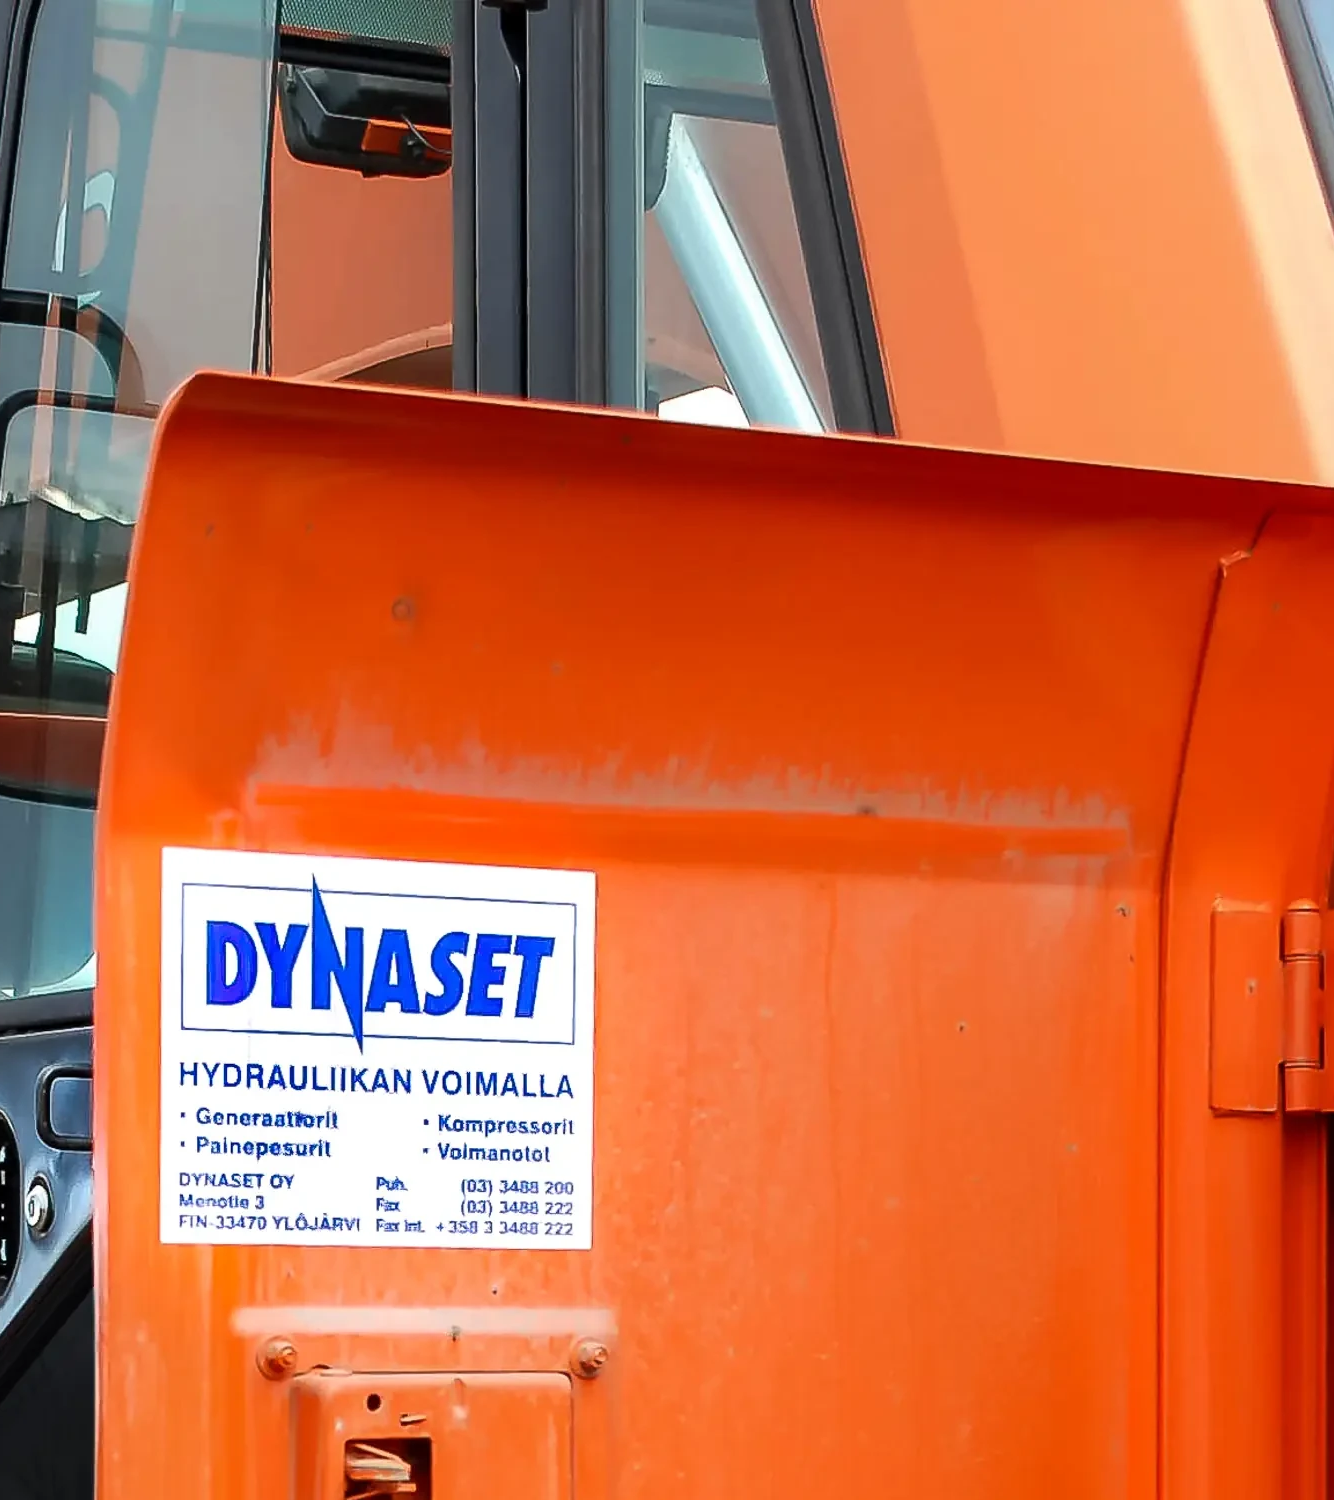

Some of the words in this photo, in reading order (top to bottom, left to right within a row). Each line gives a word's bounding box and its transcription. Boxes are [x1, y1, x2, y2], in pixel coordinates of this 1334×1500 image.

[206, 874, 555, 1055] DYNASET
[179, 1062, 412, 1095] HYDRAULIIKAN
[421, 1069, 574, 1099] VOIMALLA
[196, 1107, 339, 1130] Generaattorit
[438, 1114, 575, 1137] Kompressorit
[196, 1136, 332, 1161] Painepesurit
[438, 1142, 551, 1163] Voimanotot
[179, 1172, 265, 1189] DYNASET
[269, 1174, 295, 1190] OY
[461, 1179, 493, 1199] (03)
[545, 1181, 574, 1196] 200
[255, 1196, 265, 1210] 3
[545, 1202, 573, 1216] 222
[272, 1213, 361, 1232] YLÖJÄRVI
[545, 1222, 573, 1236] 222
